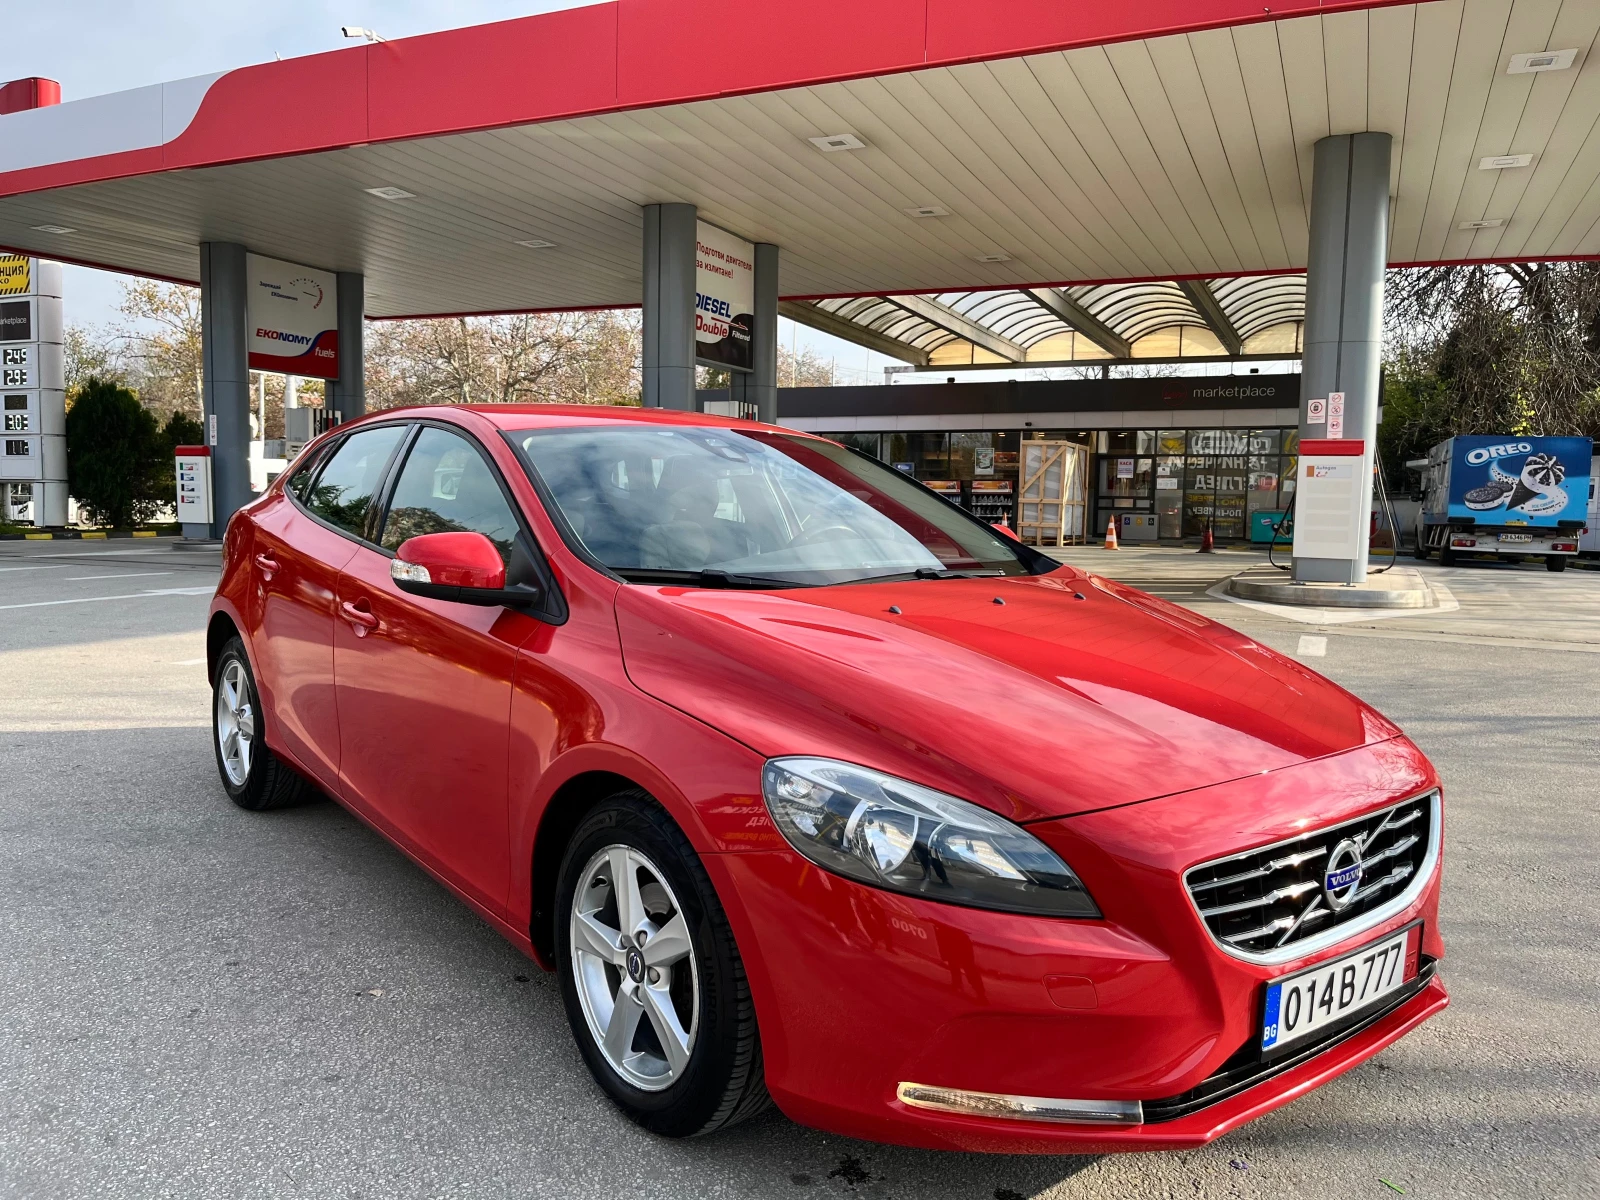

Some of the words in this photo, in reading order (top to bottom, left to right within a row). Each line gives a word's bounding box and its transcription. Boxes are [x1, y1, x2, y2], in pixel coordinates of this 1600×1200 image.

[696, 241, 725, 261] Подготви
[725, 254, 753, 272] двигателя
[0, 264, 24, 278] НЦИЯ
[704, 263, 734, 279] излитане!
[695, 292, 731, 318] DIESEL
[695, 313, 728, 338] Double
[255, 327, 312, 346] EKONOMY
[315, 346, 336, 358] fuels
[1193, 385, 1276, 399] marketplace
[1466, 442, 1532, 465] OREO
[1284, 940, 1402, 1031] 014B777
[1264, 1023, 1277, 1041] BG
